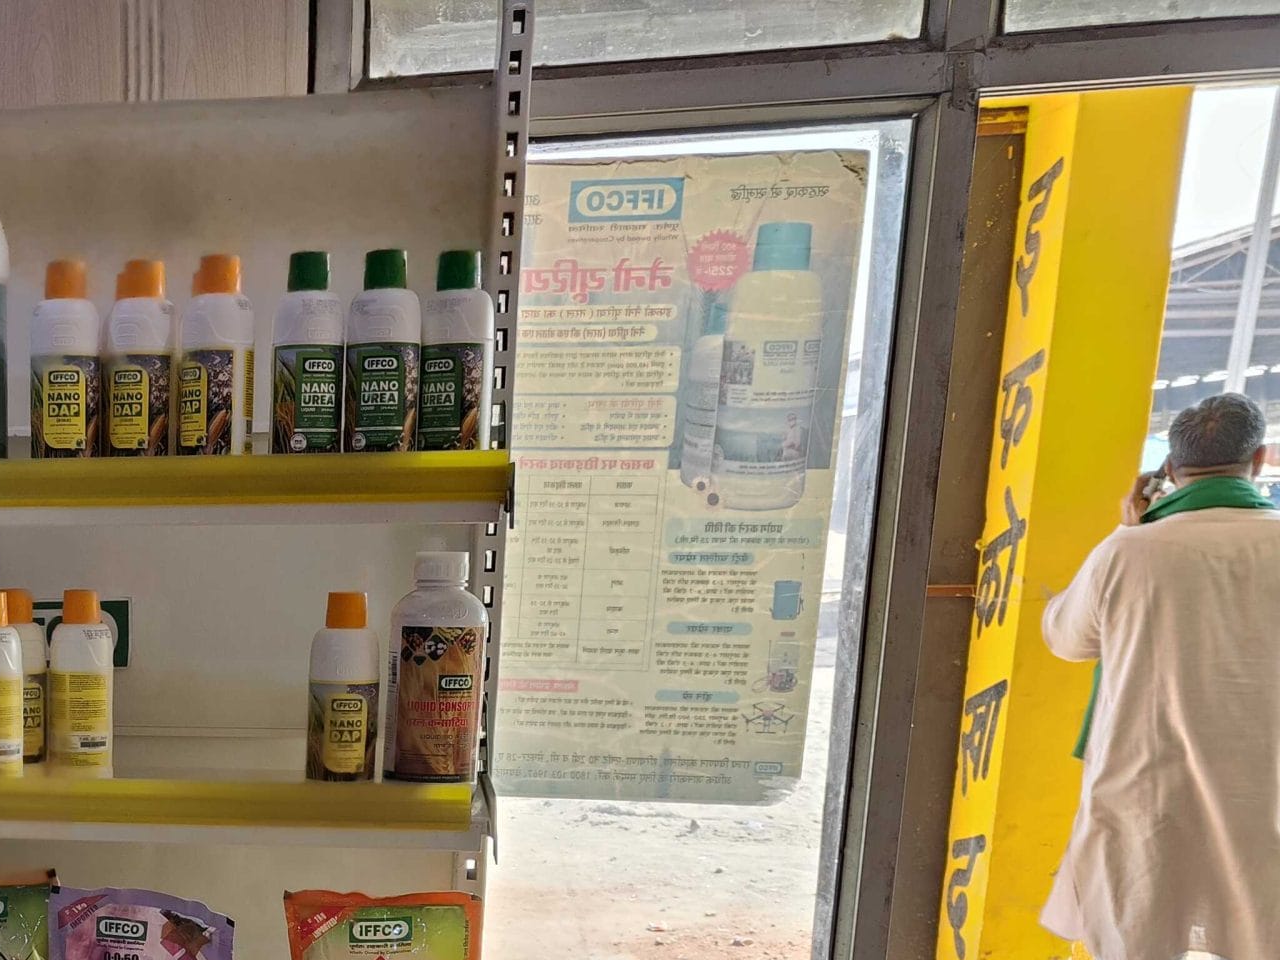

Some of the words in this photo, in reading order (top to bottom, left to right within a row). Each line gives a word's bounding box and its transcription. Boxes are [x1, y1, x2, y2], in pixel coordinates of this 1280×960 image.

[308, 360, 332, 370] IFFCO
[367, 359, 395, 369] IFFCO
[426, 360, 451, 370] IFFCO
[52, 372, 77, 382] IFFCO
[116, 372, 139, 382] IFFCO
[301, 383, 336, 393] NANO
[361, 380, 399, 391] NANO
[422, 382, 456, 393] NANO
[47, 392, 81, 402] NANO
[112, 391, 143, 402] NANO
[303, 395, 335, 406] UREA
[362, 392, 397, 405] UREA
[422, 394, 454, 406] UREA
[49, 404, 80, 416] DAP
[114, 404, 142, 416] DAP
[444, 678, 470, 688] IFFCO
[335, 701, 359, 710] IFFCO
[329, 719, 362, 728] NANO
[330, 730, 361, 742] DAP
[104, 921, 140, 935] IFFCO
[358, 924, 403, 937] IFFCO
